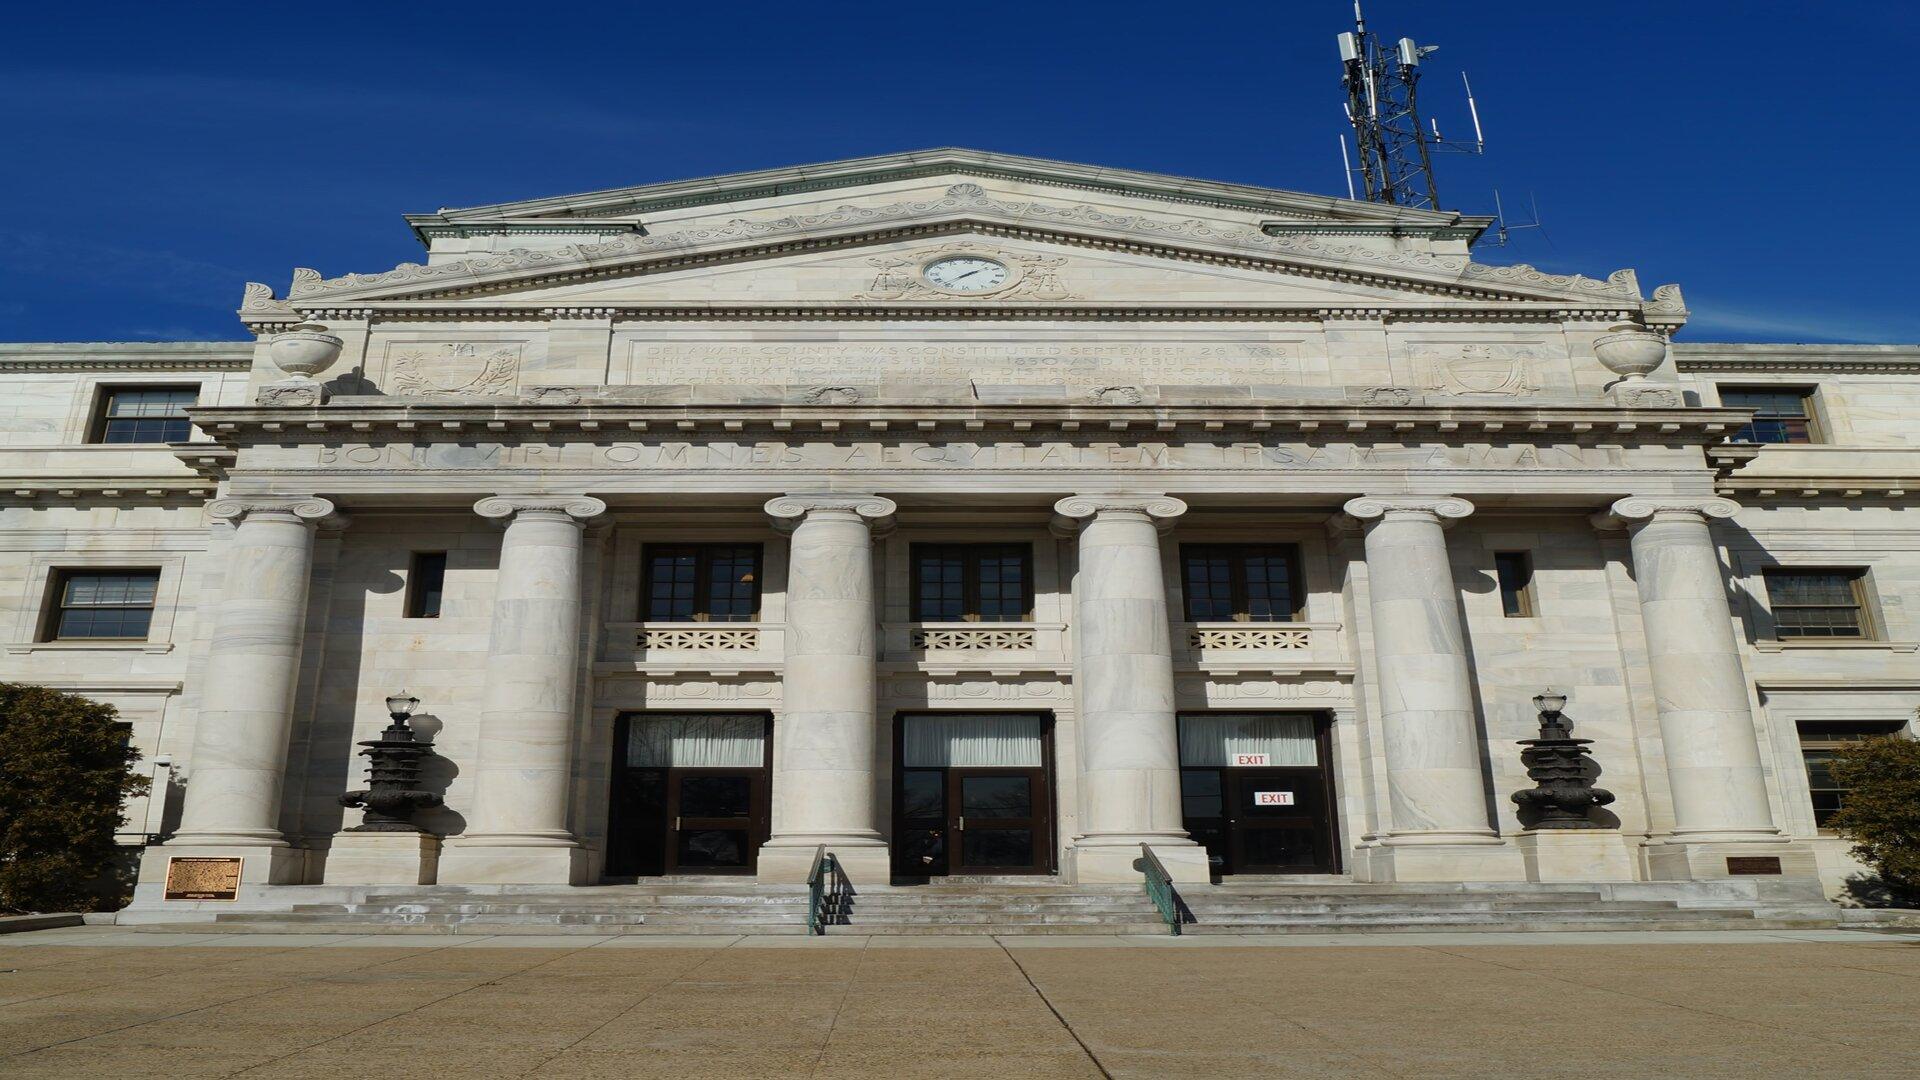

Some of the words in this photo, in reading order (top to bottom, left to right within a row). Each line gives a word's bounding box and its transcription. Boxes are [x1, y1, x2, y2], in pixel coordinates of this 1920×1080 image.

[647, 347, 752, 355] DELAWARE
[760, 347, 849, 355] COUNTY
[859, 346, 899, 355] WAS
[906, 346, 1061, 355] CONSTITUTED
[1070, 347, 1185, 356] SEPTEMBER
[1200, 347, 1226, 356] 26
[647, 357, 692, 365] THIS
[702, 357, 775, 365] COURT
[785, 357, 856, 365] HOUSE
[862, 357, 902, 365] WAS
[911, 357, 965, 365] BUILT
[975, 357, 996, 365] IN
[1006, 356, 1058, 366] 1850
[1070, 357, 1113, 366] AND
[1124, 357, 1207, 366] REBUILT
[646, 367, 661, 375] IT
[669, 367, 686, 375] IS
[694, 367, 731, 375] THE
[739, 367, 801, 376] SIXTH
[810, 367, 838, 375] OF
[846, 367, 889, 375] THIS
[896, 367, 992, 376] JUDICIAL
[1000, 367, 1096, 376] DISTRICT
[1103, 368, 1122, 376] IN
[1128, 367, 1174, 376] LINE
[1180, 367, 1208, 376] OF
[1213, 367, 1290, 376] DIRECT
[646, 377, 776, 386] SUCCESSION
[786, 377, 844, 386] FROM
[851, 377, 889, 386] THE
[896, 377, 948, 386] FIRST
[1036, 377, 1105, 386] HOUSE
[317, 446, 428, 464] BONI
[477, 446, 561, 463] VIRI
[604, 446, 803, 464] OMNES
[1222, 445, 1379, 464] IPSAM
[1425, 446, 1623, 464] AMANT
[1239, 756, 1264, 764] EXIT
[1261, 794, 1287, 803] EXIT
